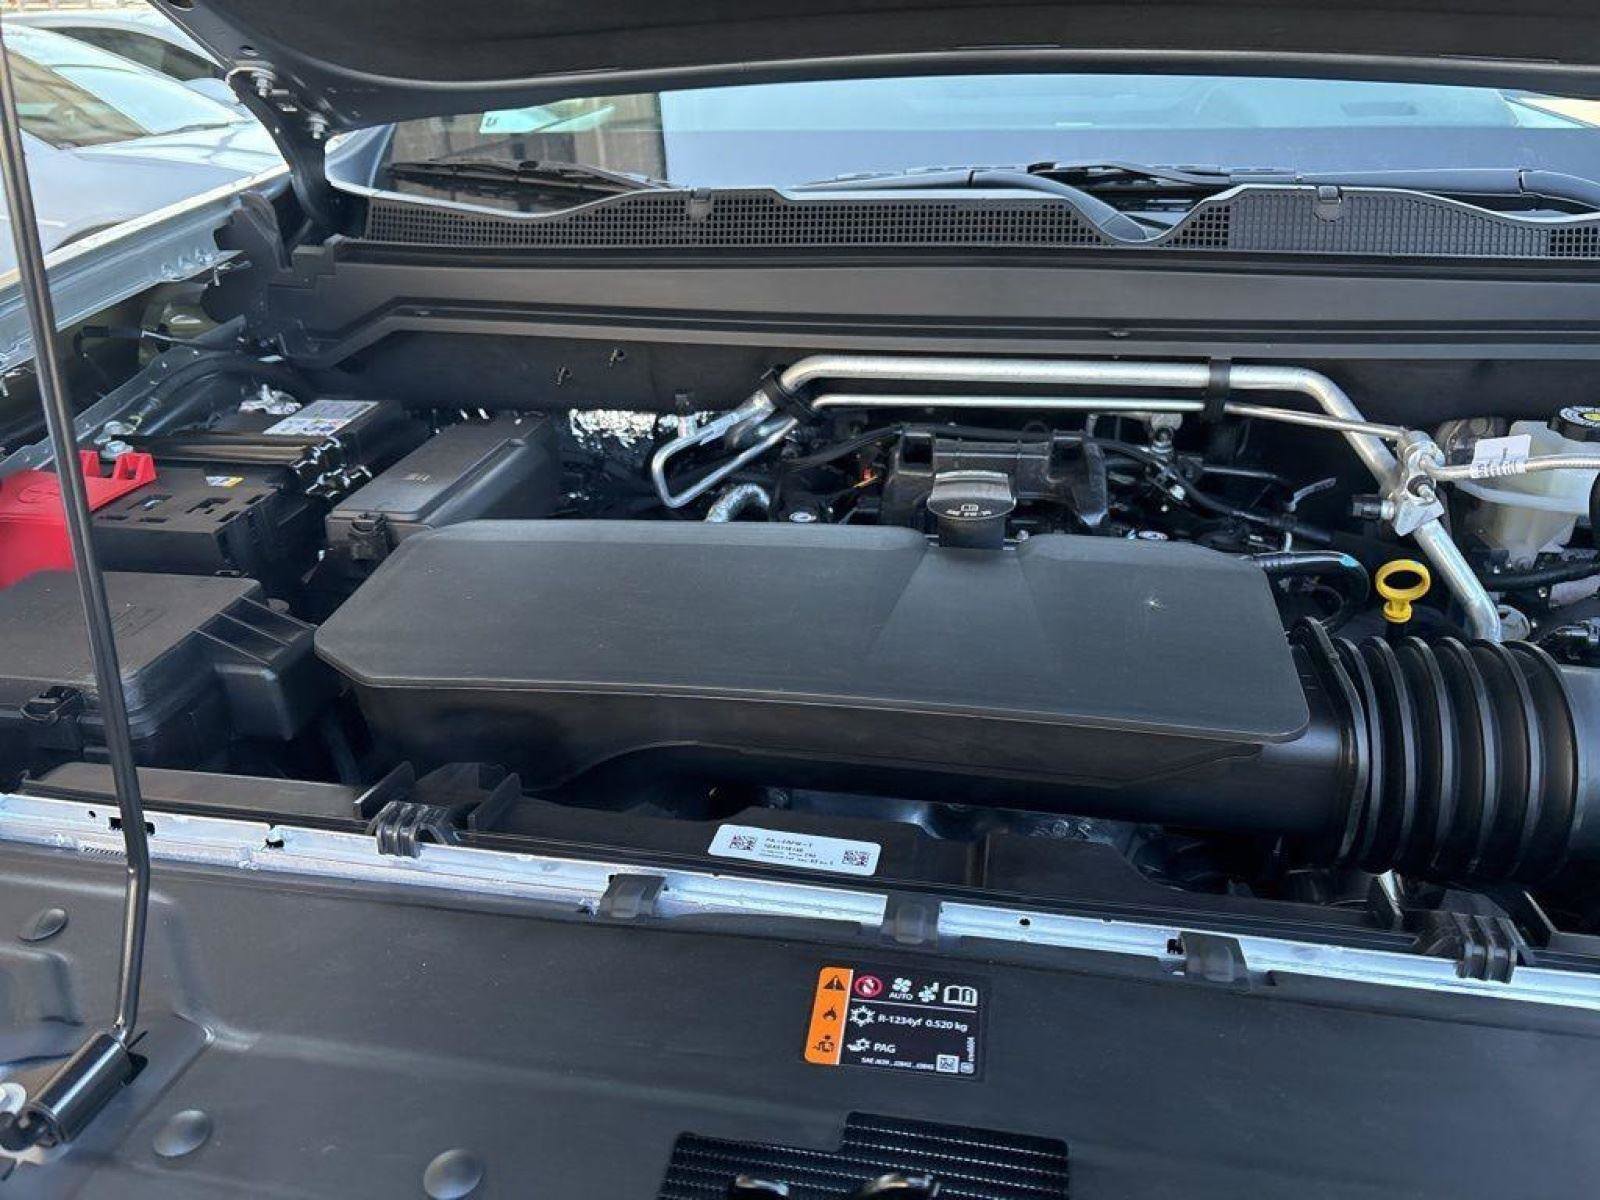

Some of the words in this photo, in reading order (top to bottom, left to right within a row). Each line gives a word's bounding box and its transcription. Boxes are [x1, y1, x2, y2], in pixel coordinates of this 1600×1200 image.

[888, 991, 913, 1001] AUTO
[877, 1014, 923, 1028] R-1234yf
[925, 1018, 954, 1030] 0.520
[955, 1021, 968, 1033] kg
[873, 1042, 896, 1054] PAG
